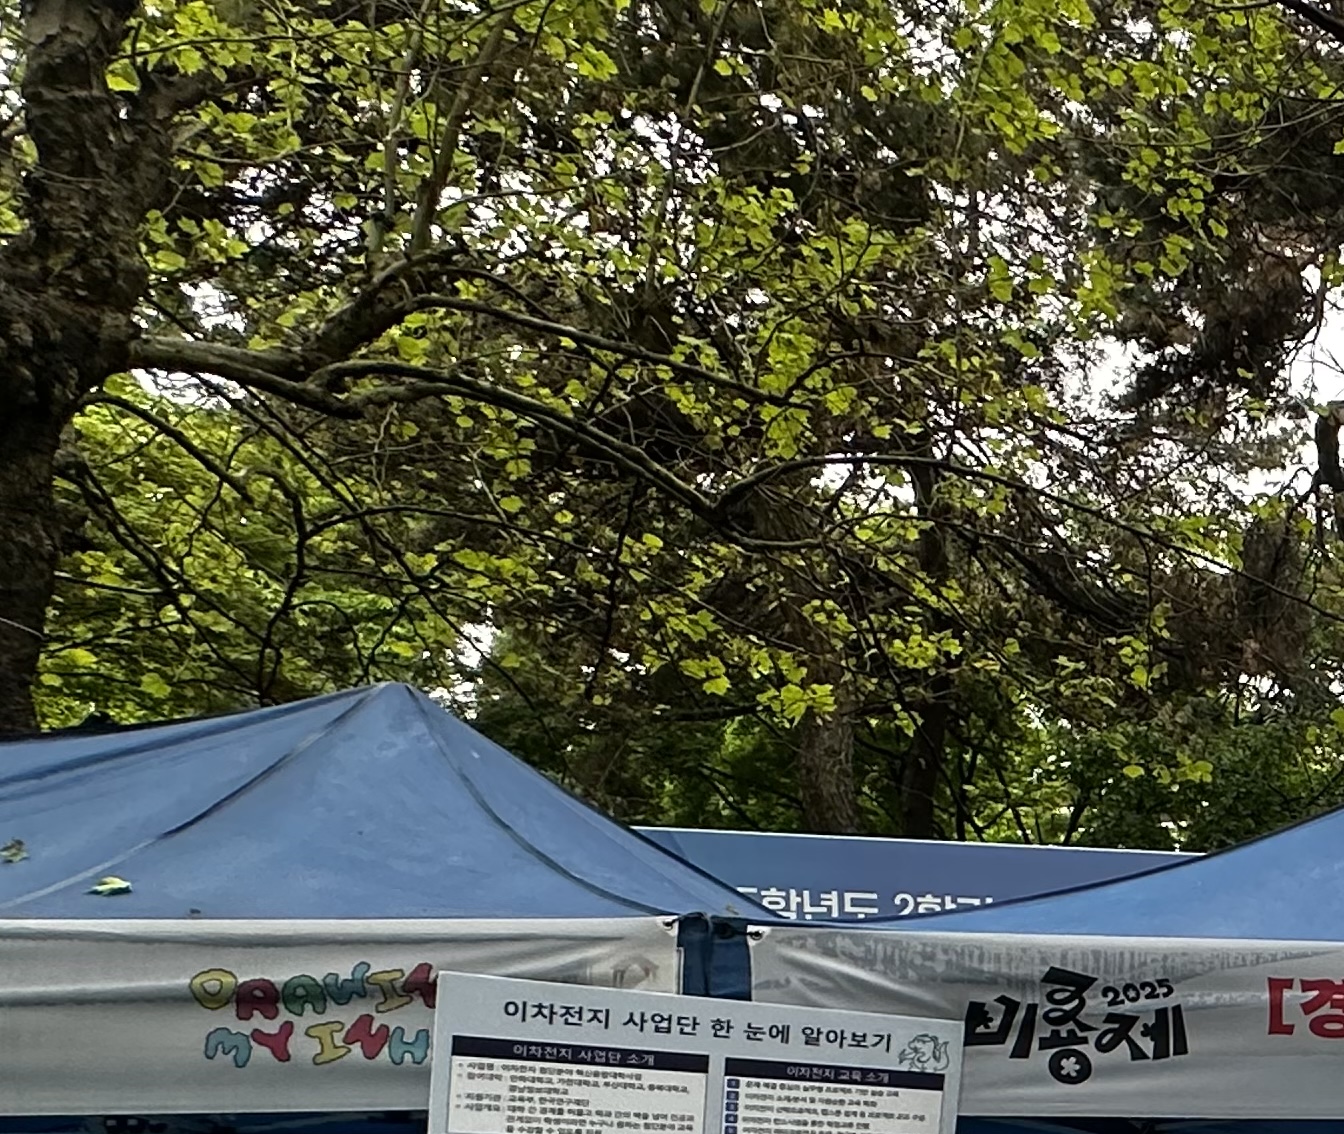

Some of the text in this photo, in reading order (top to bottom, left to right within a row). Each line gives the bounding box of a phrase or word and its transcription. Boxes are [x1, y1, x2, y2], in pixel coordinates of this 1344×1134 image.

[190, 962, 438, 1020] DRAWIN
[1102, 978, 1174, 1007] 2025
[204, 1014, 429, 1068] MY INH
[504, 1000, 892, 1053] 이차전지 사업단 한 눈에 알아보기
[513, 1043, 655, 1066] 이차전지 사업단 소개
[787, 1066, 890, 1084] 이차전지 교육 소개
